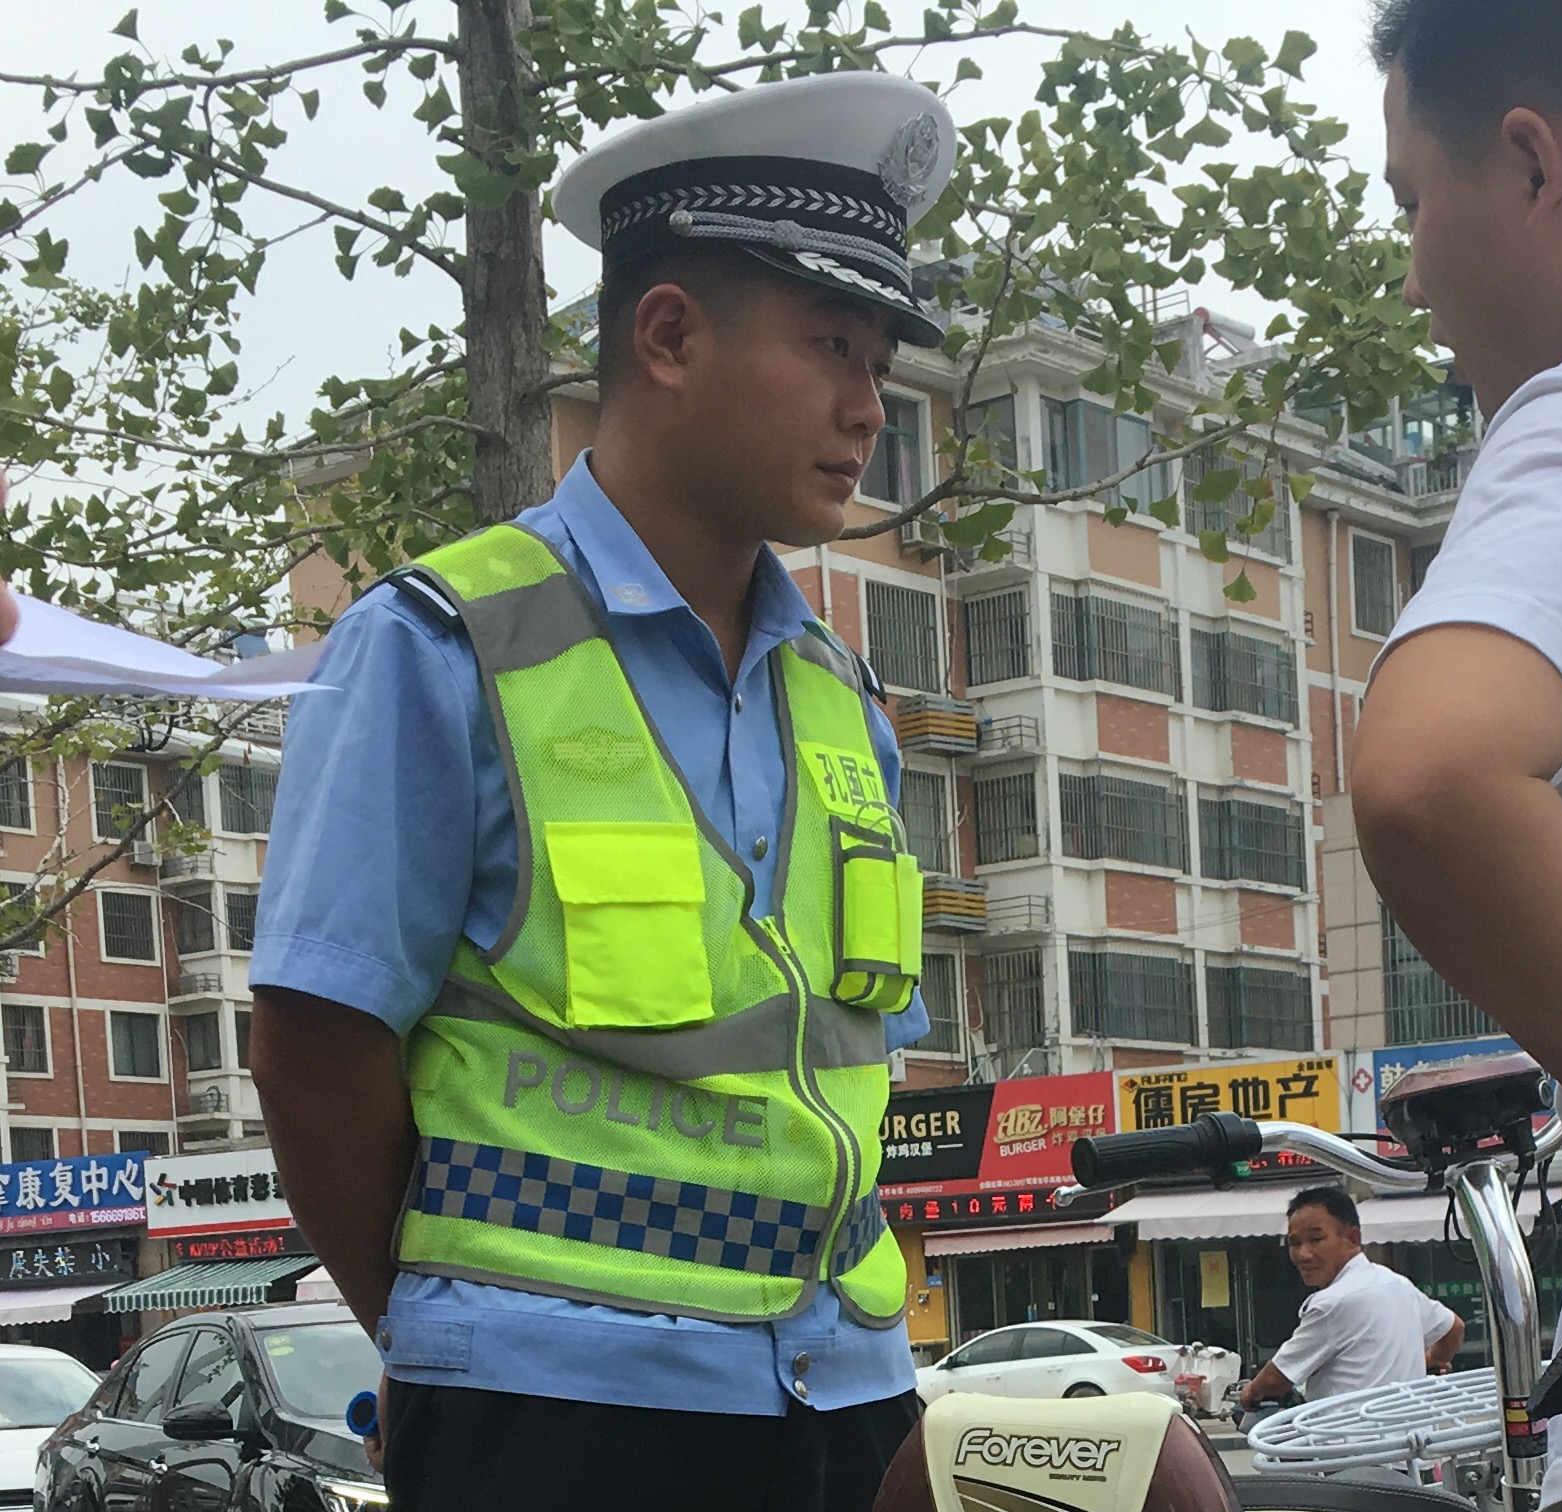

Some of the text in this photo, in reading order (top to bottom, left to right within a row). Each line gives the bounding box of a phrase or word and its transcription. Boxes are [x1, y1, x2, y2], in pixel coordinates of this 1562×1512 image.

[503, 1049, 768, 1148] POLICE
[1050, 1104, 1105, 1128] 阿堡仔
[1000, 1138, 1047, 1157] BURGER
[955, 1427, 1122, 1472] Forever
